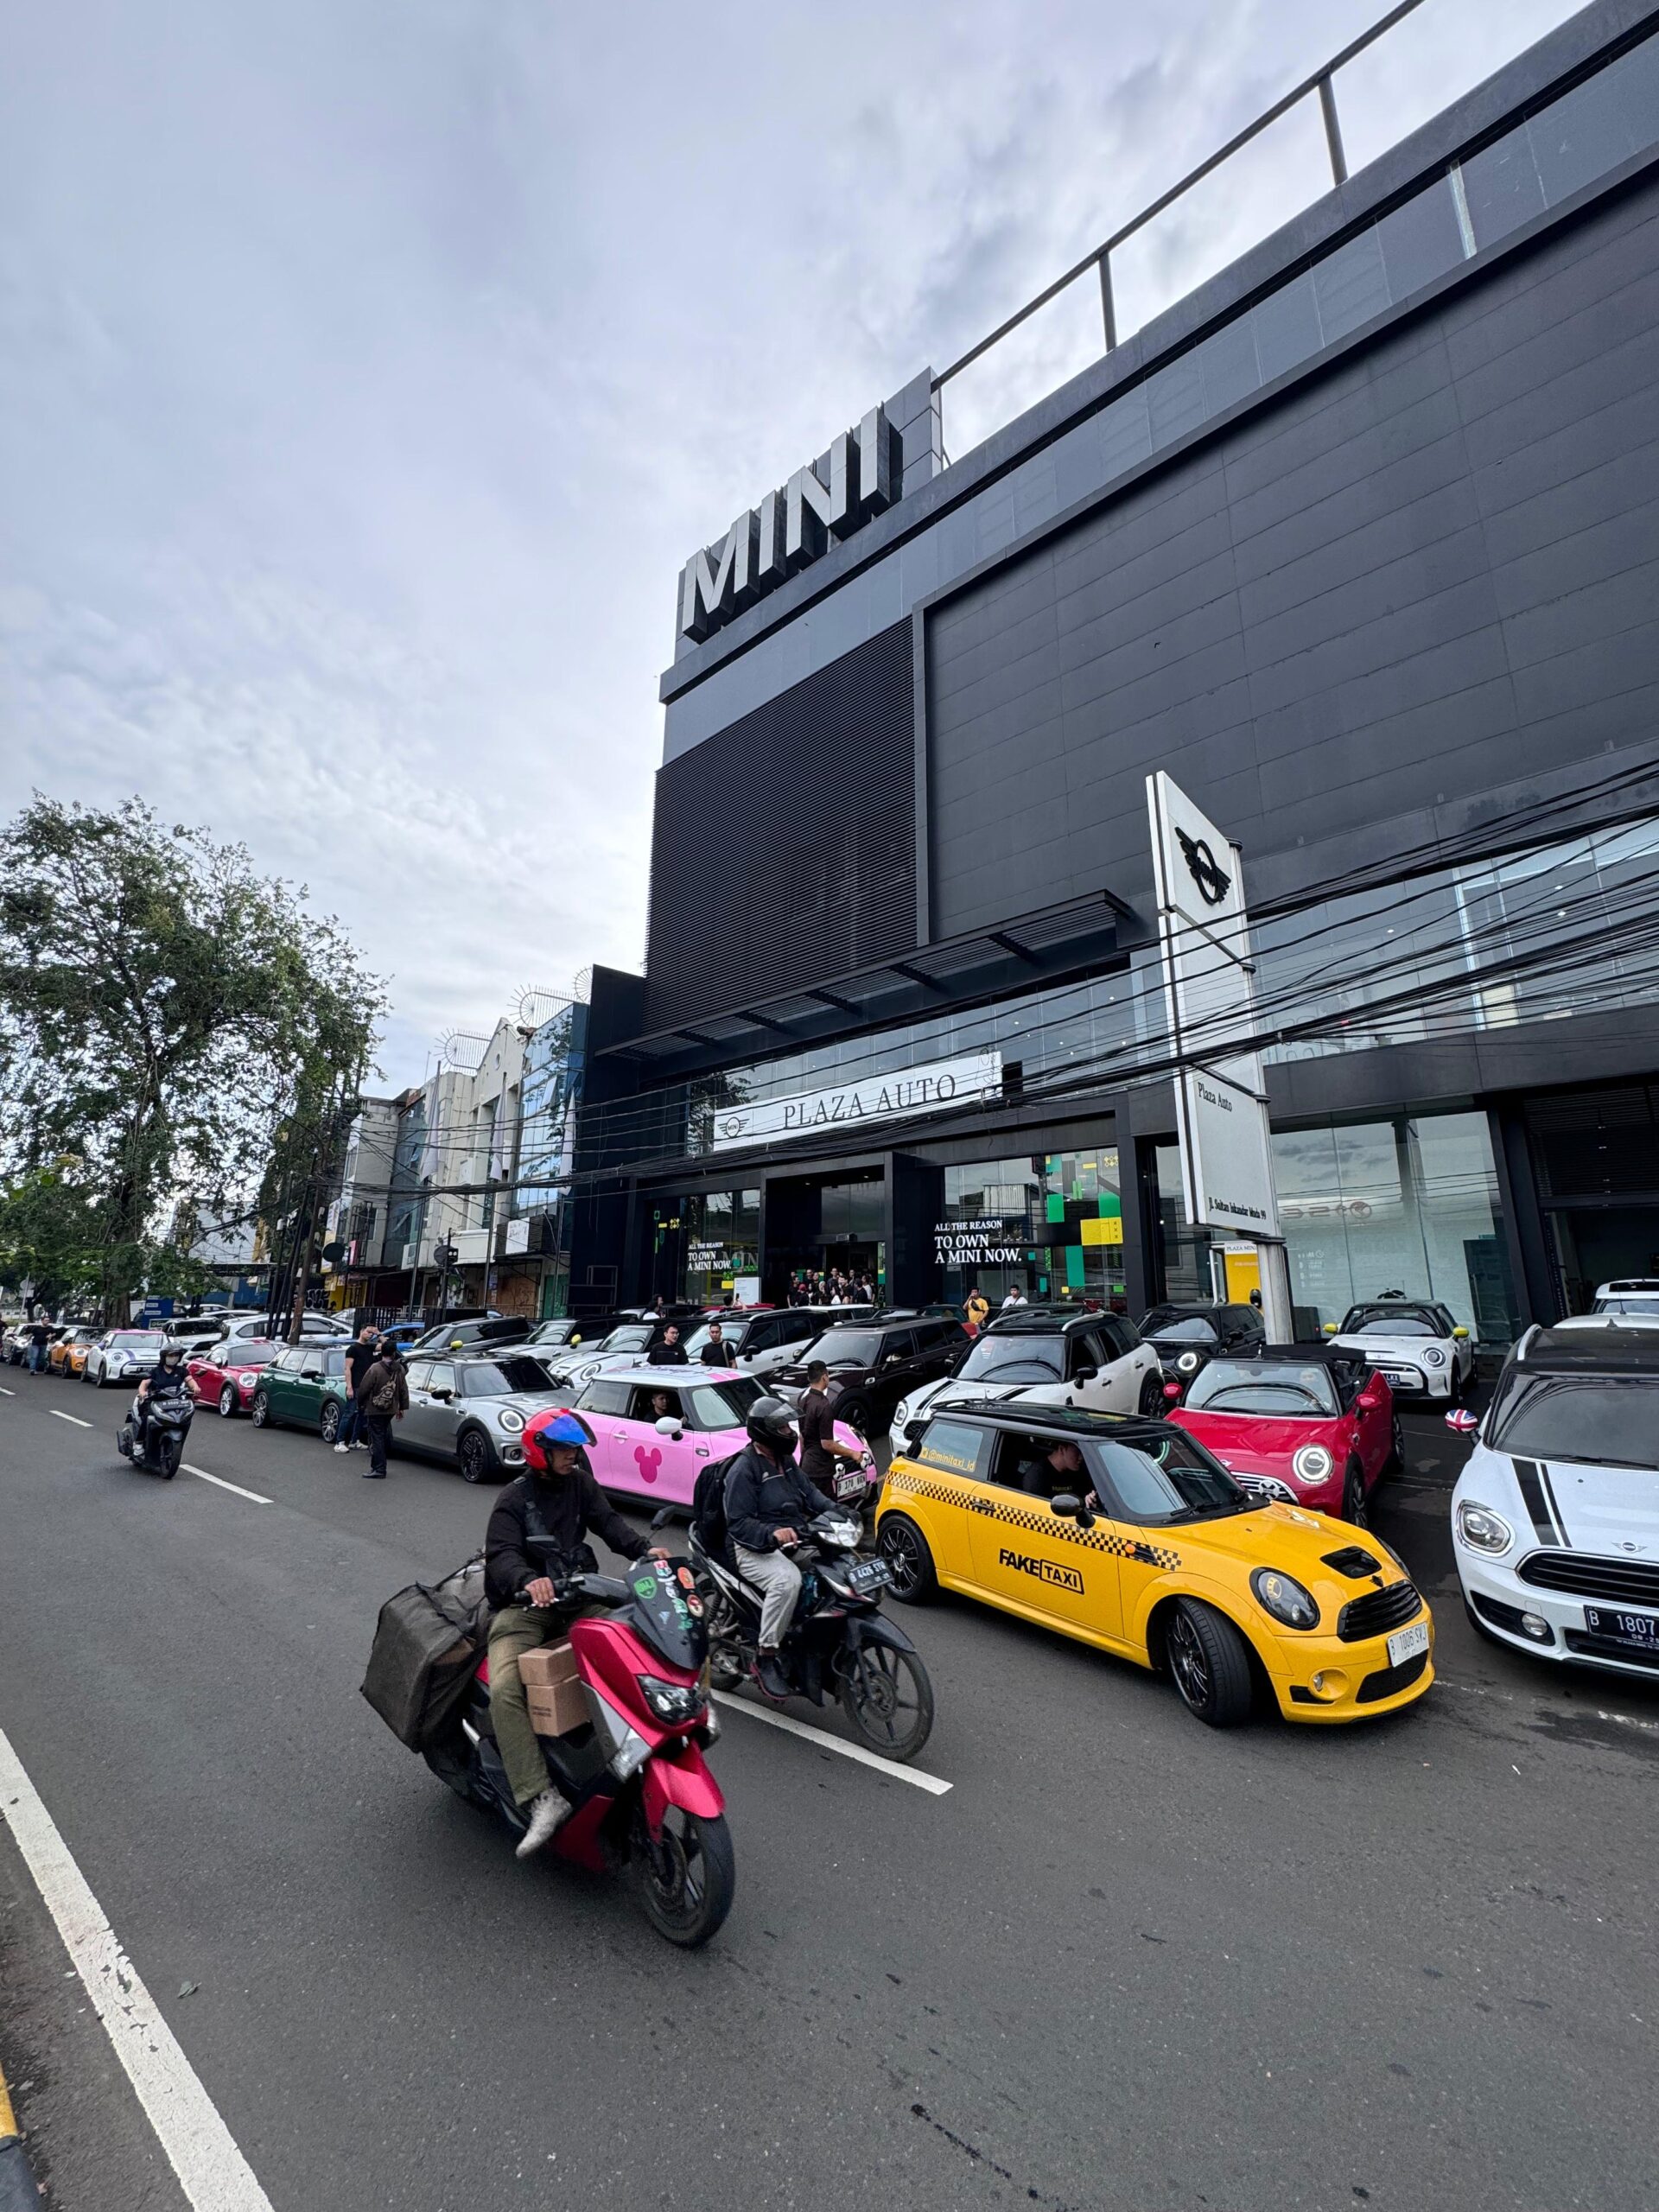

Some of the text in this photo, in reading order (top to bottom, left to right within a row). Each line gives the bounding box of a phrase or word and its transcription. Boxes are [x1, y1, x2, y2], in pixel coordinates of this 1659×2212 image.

[681, 404, 887, 639] MINI
[783, 1074, 957, 1129] PLAZA AUTO
[1197, 1082, 1233, 1112] Plaza Auto
[1214, 1198, 1230, 1212] Sultan
[935, 1219, 1003, 1231] ALL THE REASON
[935, 1234, 989, 1249] TO OWN
[688, 1251, 716, 1262] TO OWN
[935, 1247, 1022, 1263] A MINI NOW.
[694, 1262, 712, 1271] MINI
[713, 1260, 732, 1270] NOW.
[998, 1548, 1081, 1591] FAKE TAXI
[1588, 1610, 1656, 1637] B 1807
